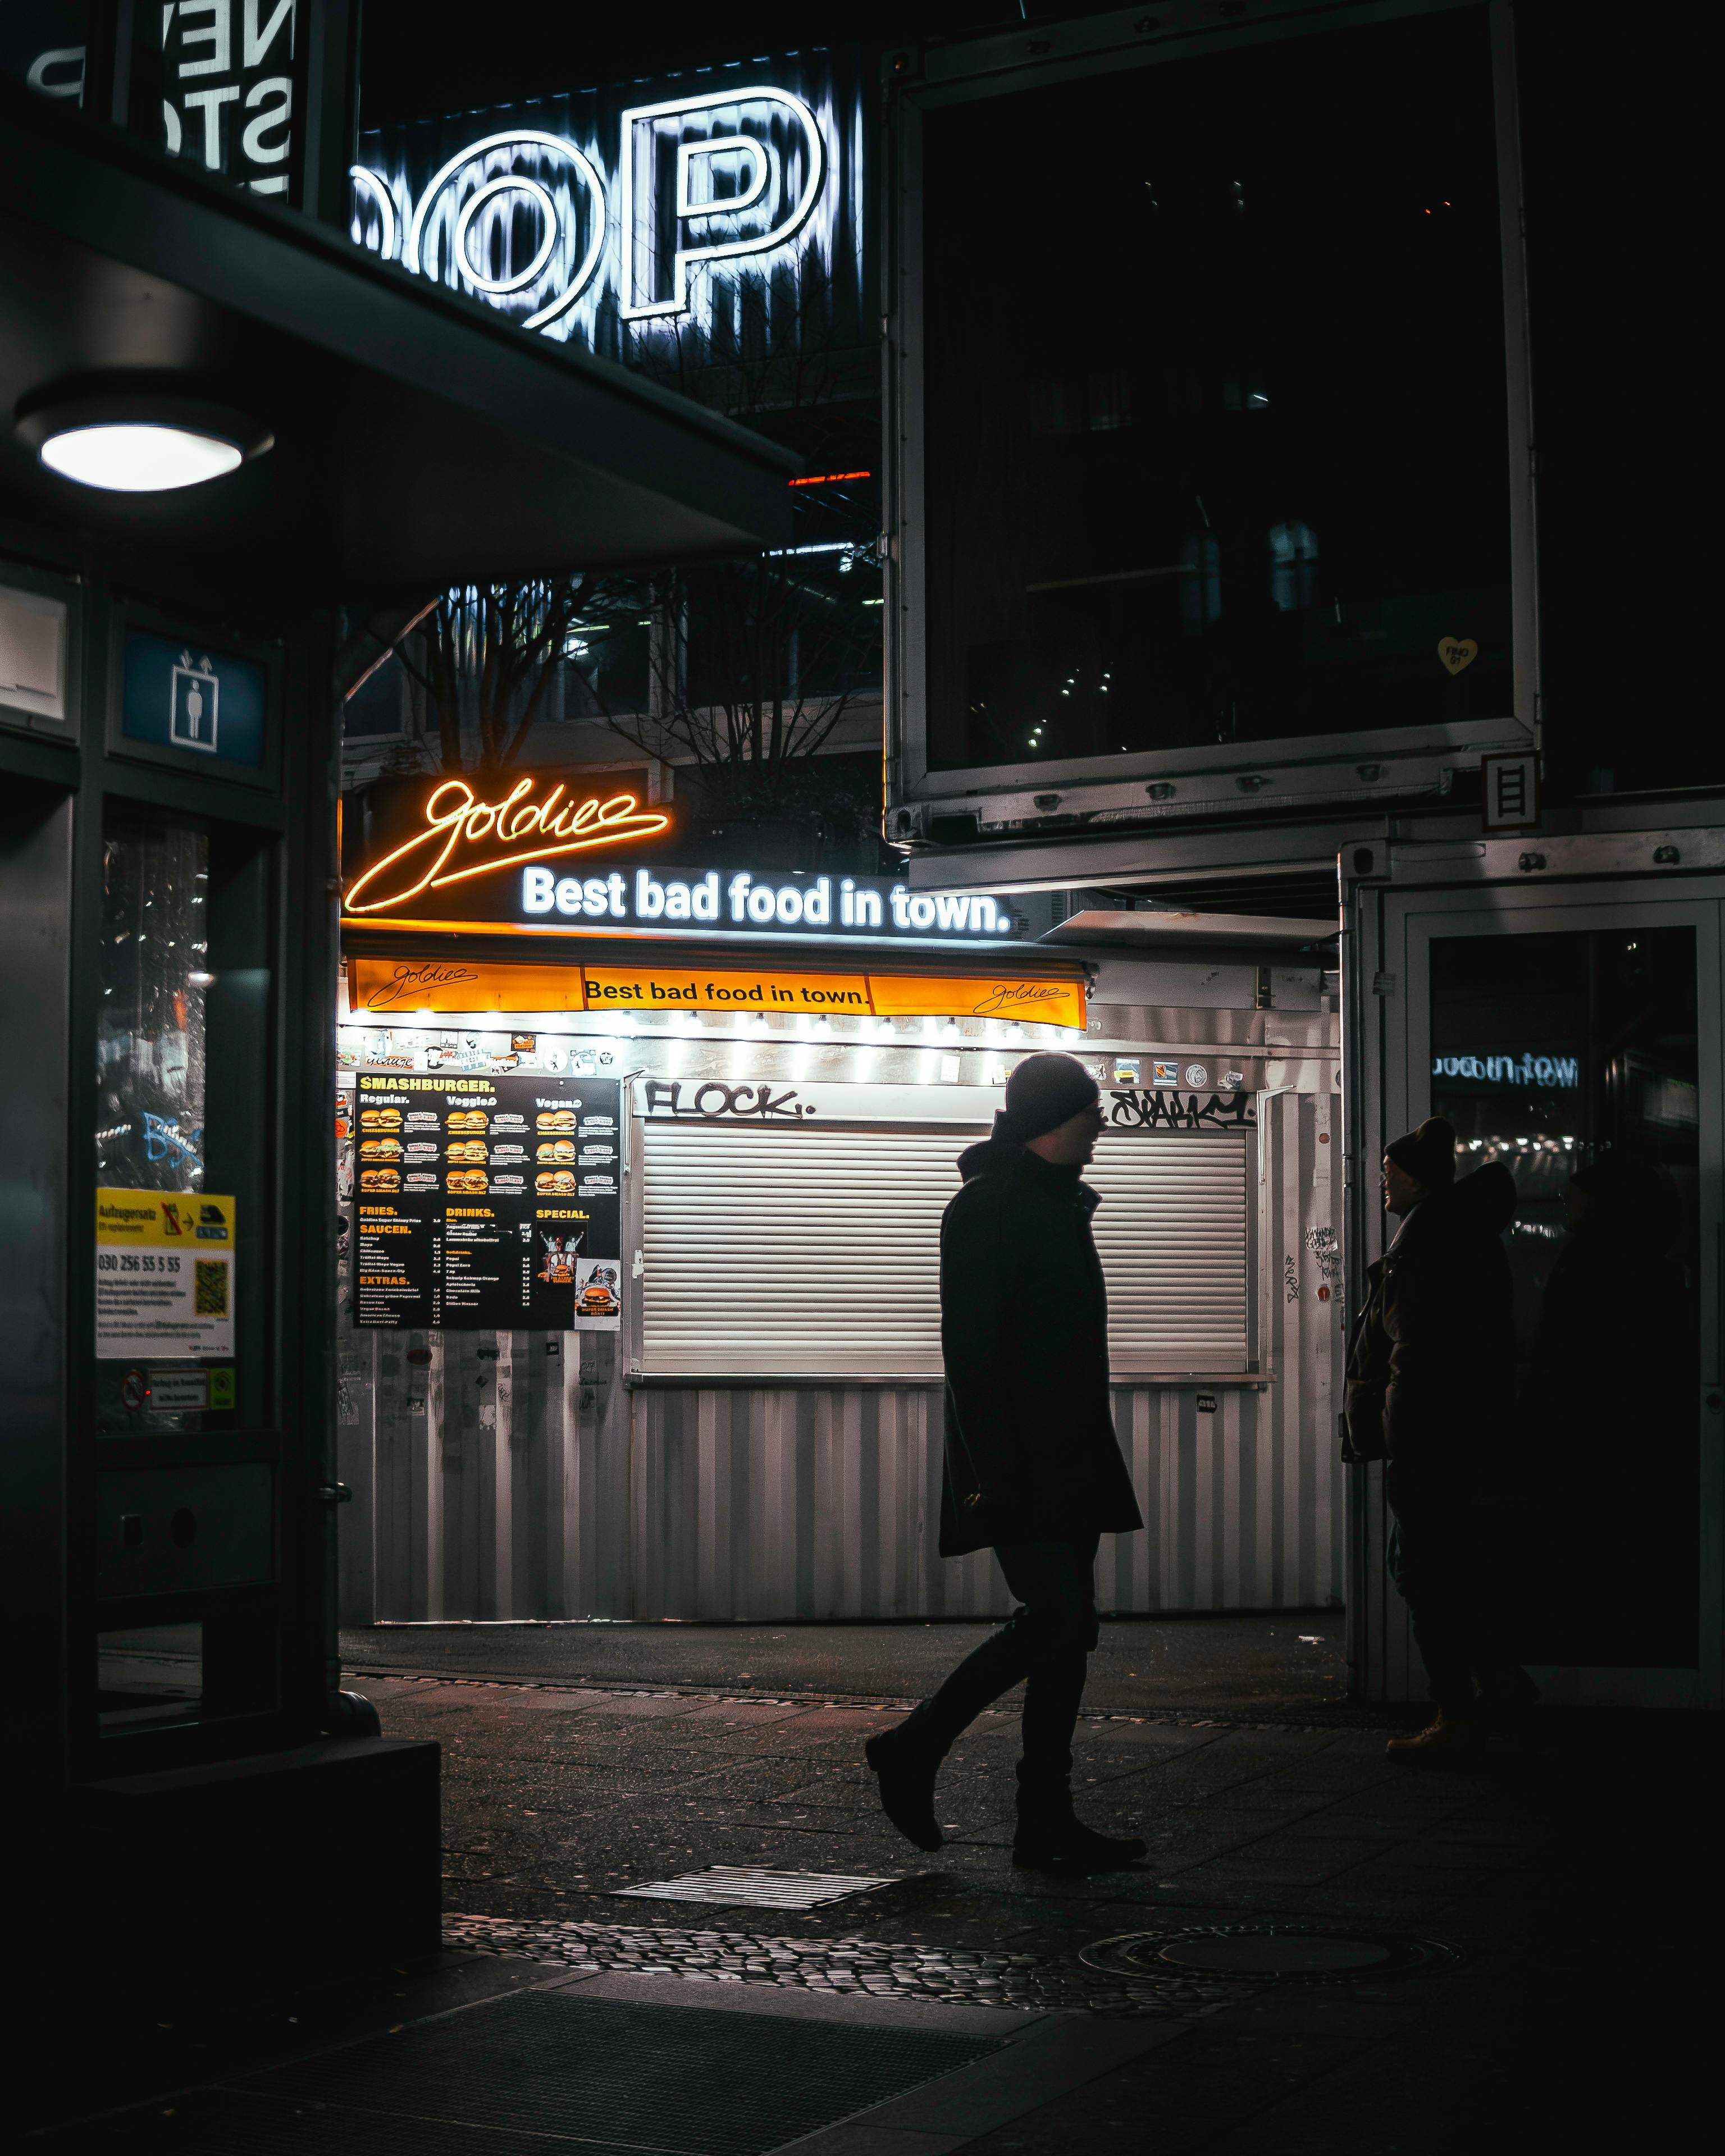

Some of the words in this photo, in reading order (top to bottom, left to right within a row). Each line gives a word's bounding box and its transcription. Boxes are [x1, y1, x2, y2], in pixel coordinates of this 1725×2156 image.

[350, 85, 825, 329] OP
[523, 866, 627, 918] Best
[636, 869, 721, 921] bad
[728, 871, 832, 924] food
[840, 878, 883, 926] in
[891, 885, 1011, 932] town.
[585, 980, 644, 999] Best
[650, 981, 698, 1000] bad
[705, 983, 764, 1001] food
[770, 985, 794, 1002] in
[360, 1077, 495, 1093] SMASHBURGER.
[360, 1094, 410, 1105] Regular.
[446, 1095, 488, 1108] Veggie
[535, 1098, 574, 1109] Vegan
[360, 1206, 398, 1216] FRIES.
[446, 1208, 495, 1217] DRINKS.
[536, 1210, 590, 1219] SPECIAL.
[360, 1225, 412, 1234] SAUCEN.
[99, 1254, 117, 1271] 030
[360, 1276, 410, 1285] EXTRAS.
